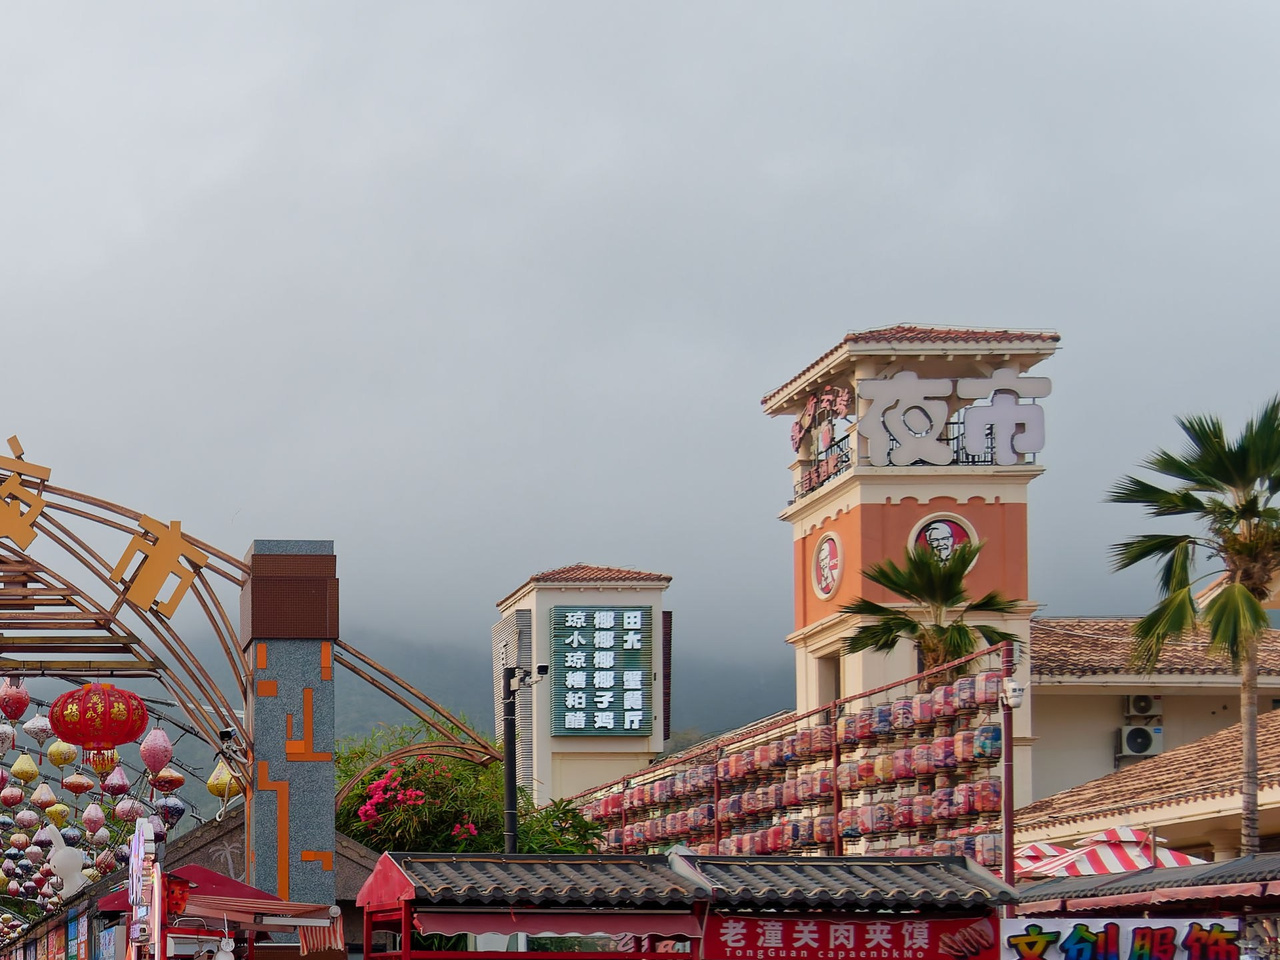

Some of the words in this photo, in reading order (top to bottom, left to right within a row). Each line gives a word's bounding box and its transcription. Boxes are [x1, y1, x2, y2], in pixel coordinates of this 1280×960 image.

[857, 368, 1052, 466] 夜市
[720, 919, 930, 949] 老潼关肉夹馍
[725, 948, 808, 959] TongGuan
